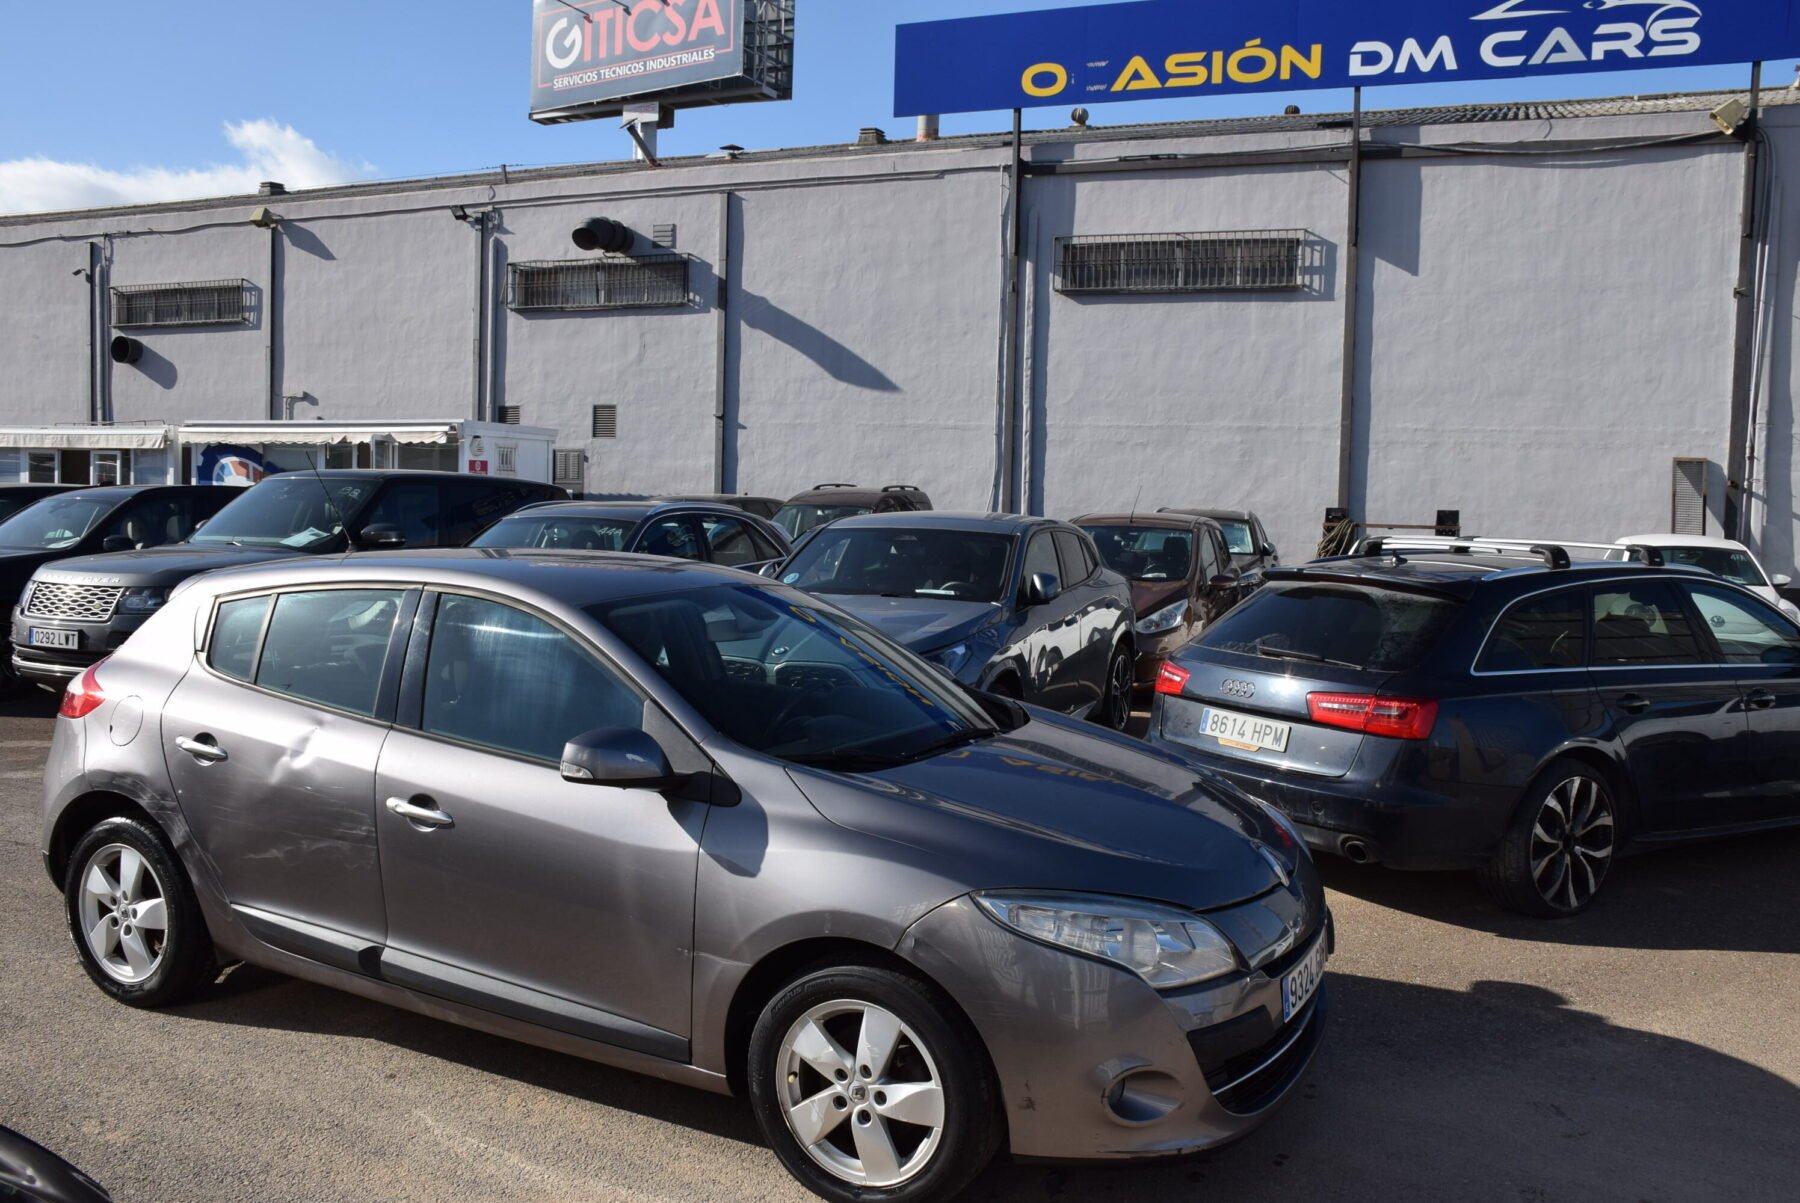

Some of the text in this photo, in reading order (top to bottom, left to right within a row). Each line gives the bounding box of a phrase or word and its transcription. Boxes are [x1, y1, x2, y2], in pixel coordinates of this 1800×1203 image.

[553, 48, 715, 89] SERVICIOS TECNICOS INDUSTRIALES
[1021, 16, 1701, 97] OASIÓN DM CARS
[35, 630, 56, 645] 0292
[1210, 714, 1246, 738] 8614
[1251, 723, 1284, 747] HPM
